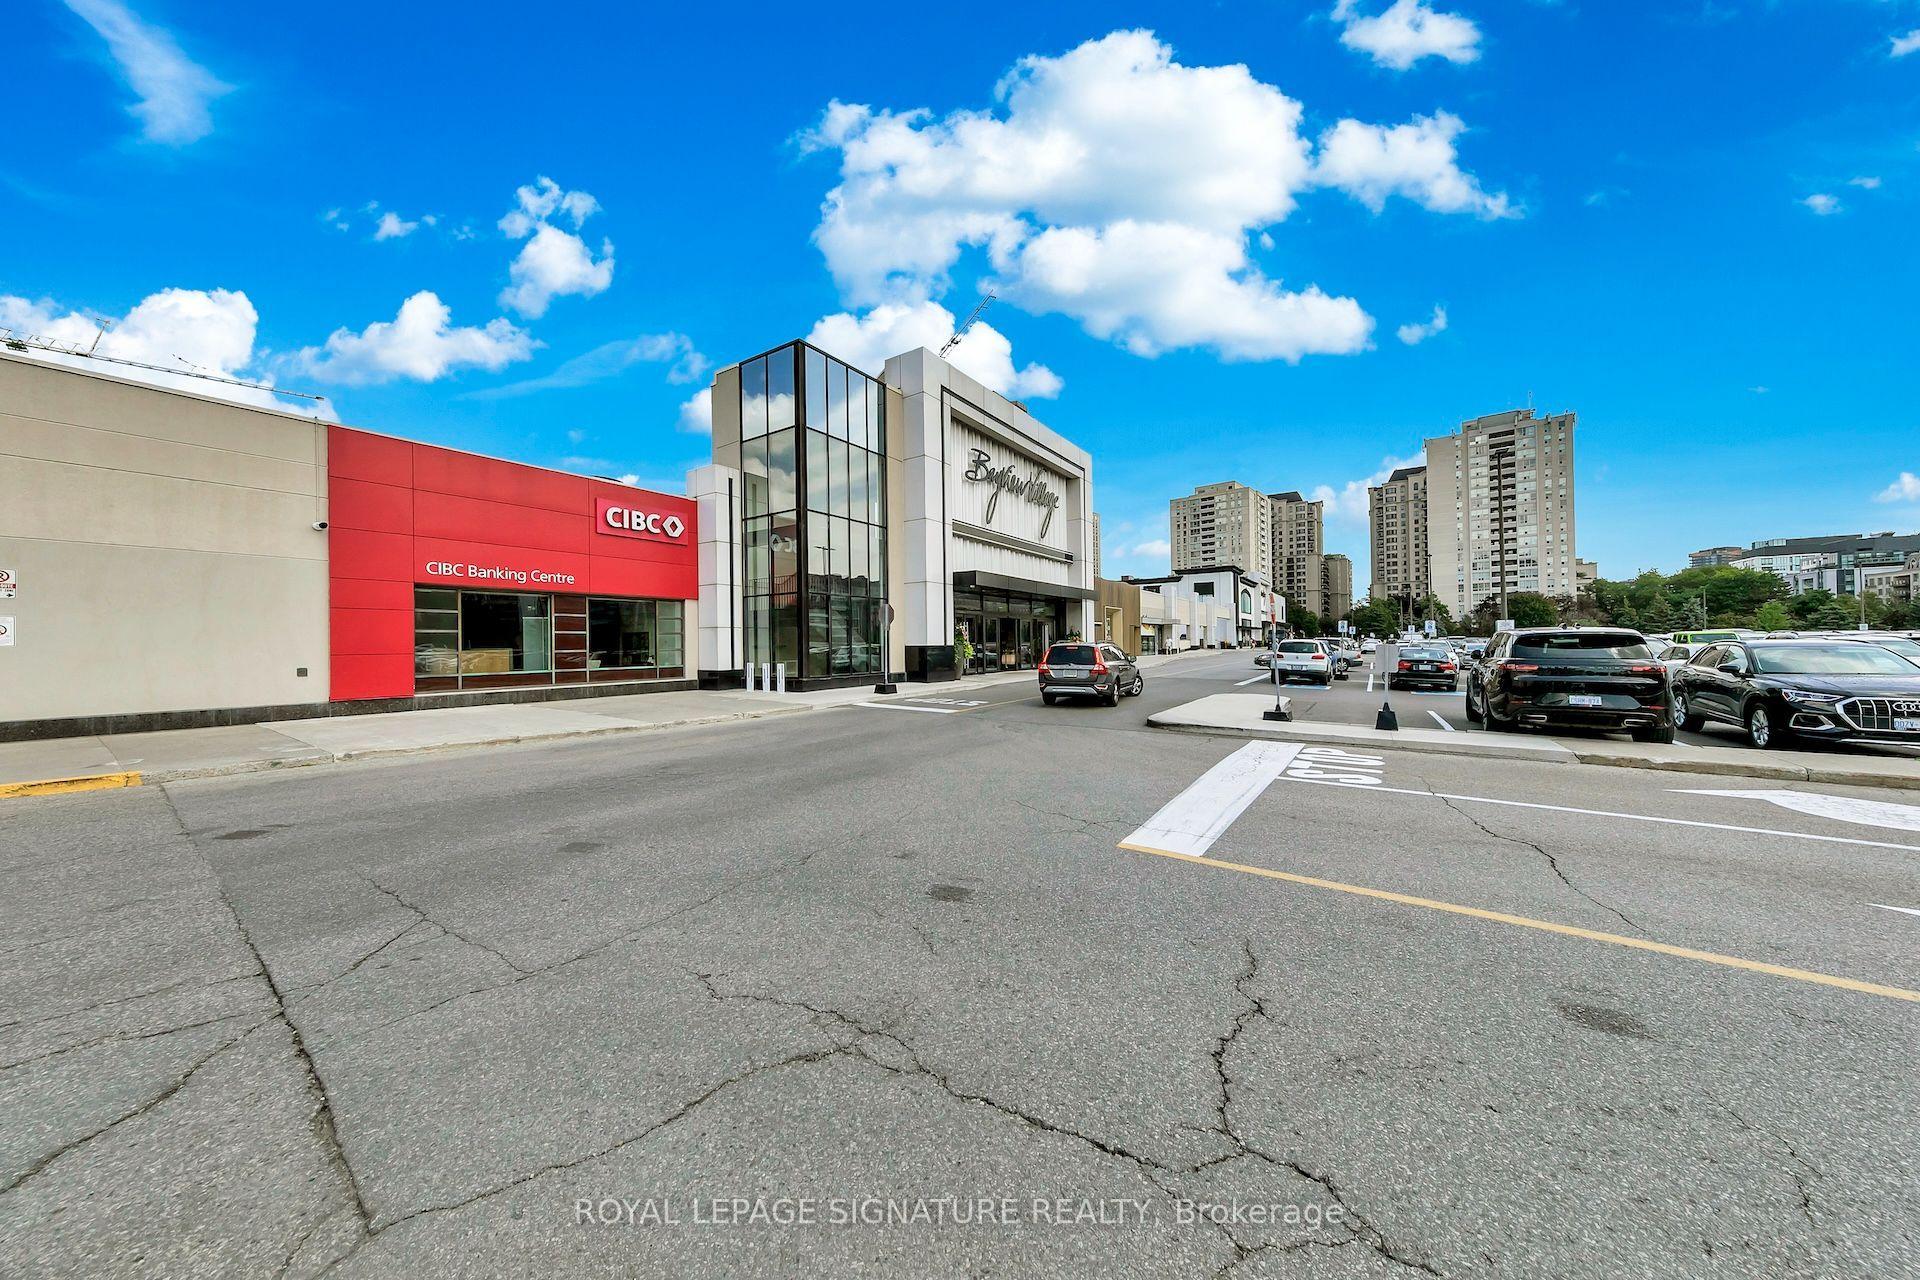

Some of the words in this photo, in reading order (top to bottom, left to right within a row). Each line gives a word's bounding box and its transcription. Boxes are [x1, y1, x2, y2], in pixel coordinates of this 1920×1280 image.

[606, 506, 661, 534] CIBC
[425, 561, 464, 577] CIBC
[467, 564, 526, 584] Banking
[530, 569, 575, 585] Centre
[1286, 747, 1386, 785] STOP
